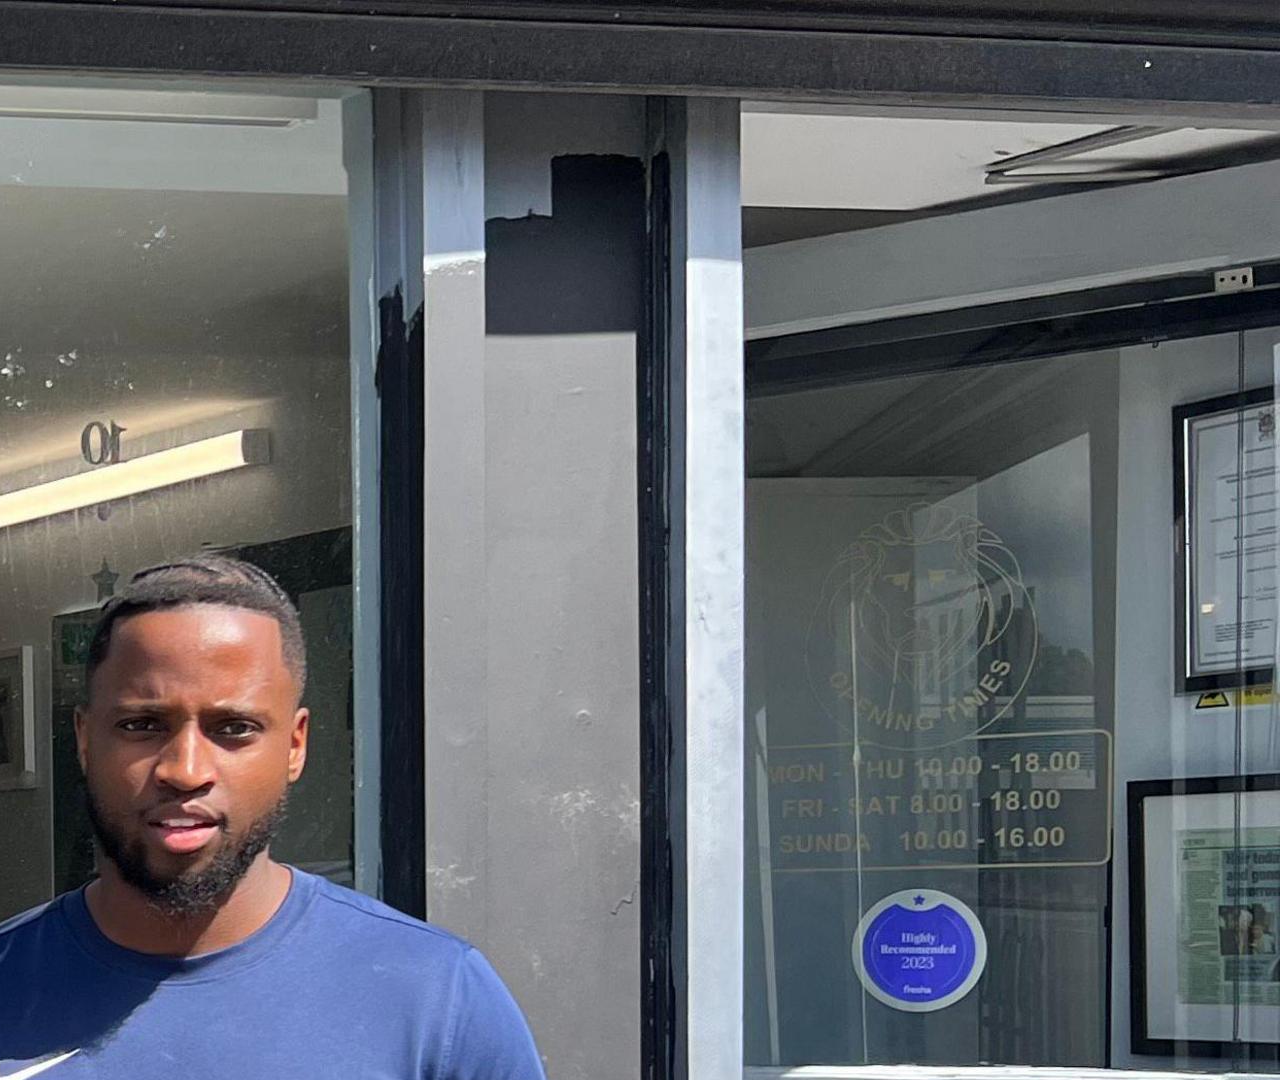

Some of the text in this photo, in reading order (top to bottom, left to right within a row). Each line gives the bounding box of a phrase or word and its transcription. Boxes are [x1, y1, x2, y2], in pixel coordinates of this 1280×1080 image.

[941, 658, 1011, 723] TIMES
[915, 756, 982, 777] 10.00
[1011, 752, 1081, 773] 18.00
[782, 799, 823, 818] FRI
[849, 796, 901, 816] SAT
[910, 794, 963, 814] 8.00
[991, 791, 1061, 811] 18.00
[899, 831, 967, 851] 10.00
[995, 827, 1065, 848] 16.00
[880, 944, 956, 954] Recommended
[901, 932, 936, 945] Highly
[901, 956, 935, 969] 2023
